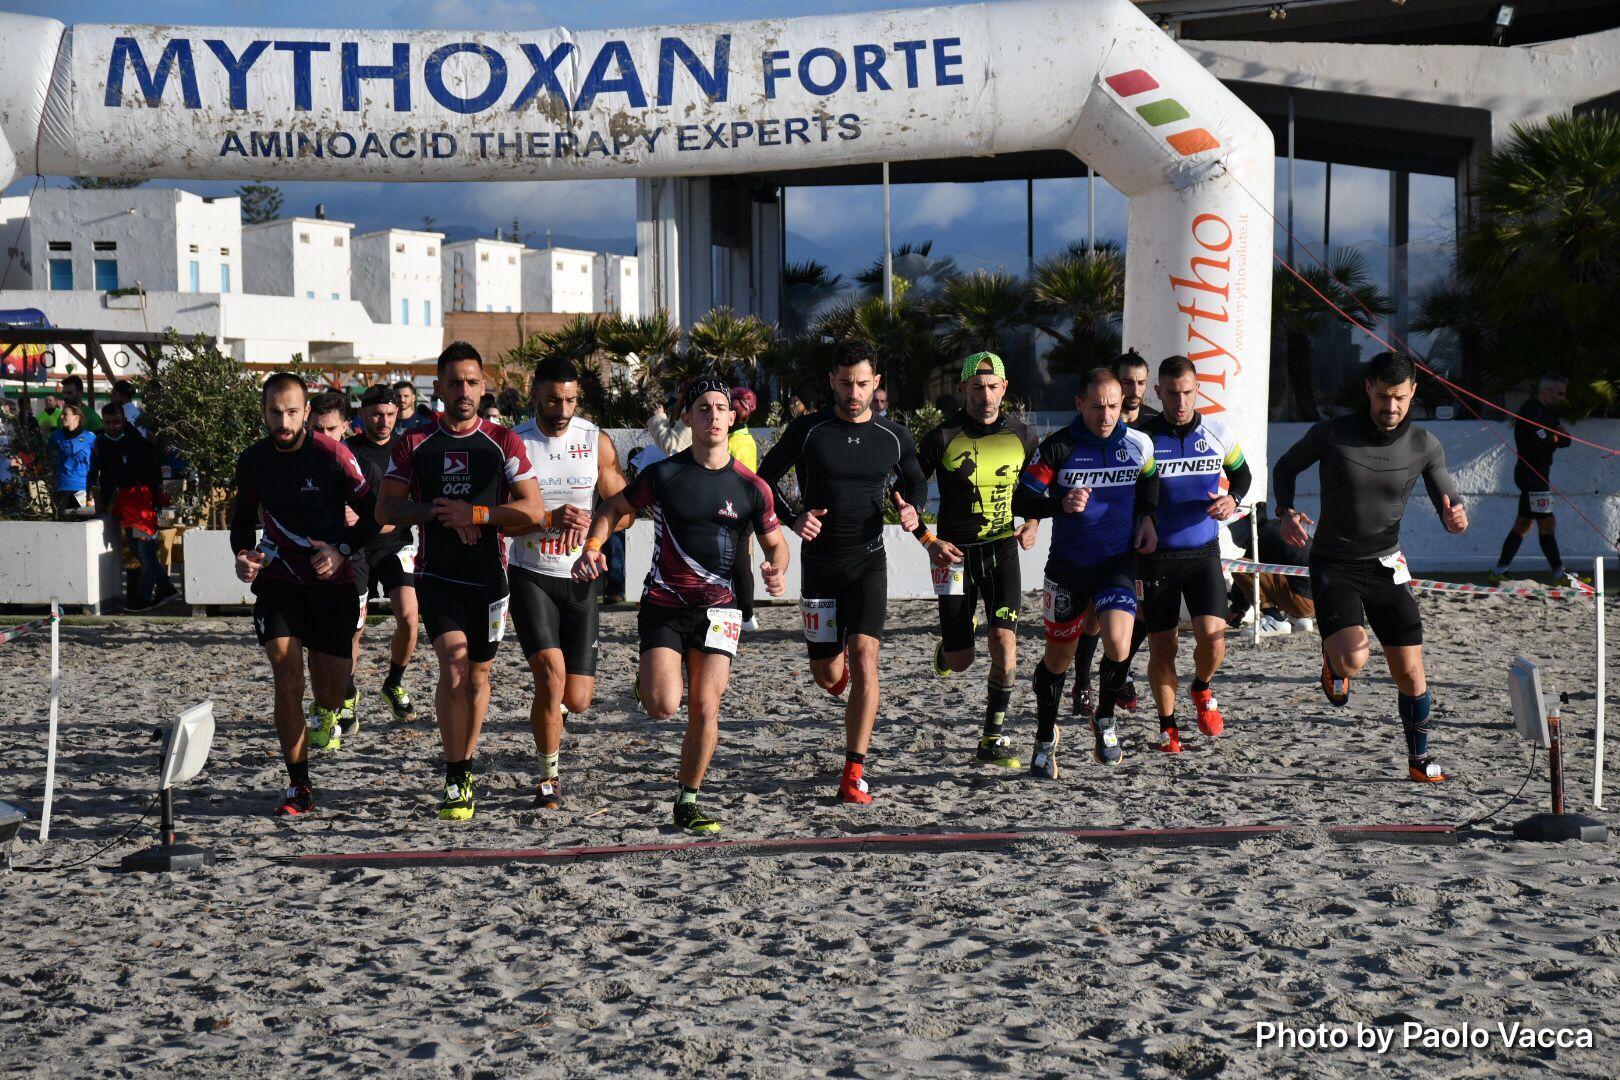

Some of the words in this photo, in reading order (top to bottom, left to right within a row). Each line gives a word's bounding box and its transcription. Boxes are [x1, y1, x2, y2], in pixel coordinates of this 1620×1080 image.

[104, 33, 731, 114] MYTHOXAN
[761, 37, 965, 99] FORTE
[219, 130, 457, 159] AMINOACID
[469, 127, 663, 159] THERAPY
[677, 113, 862, 151] EXPERTS
[1155, 459, 1222, 475] FITNESS
[1064, 470, 1140, 485] 4FITNESS
[442, 483, 472, 495] OCR
